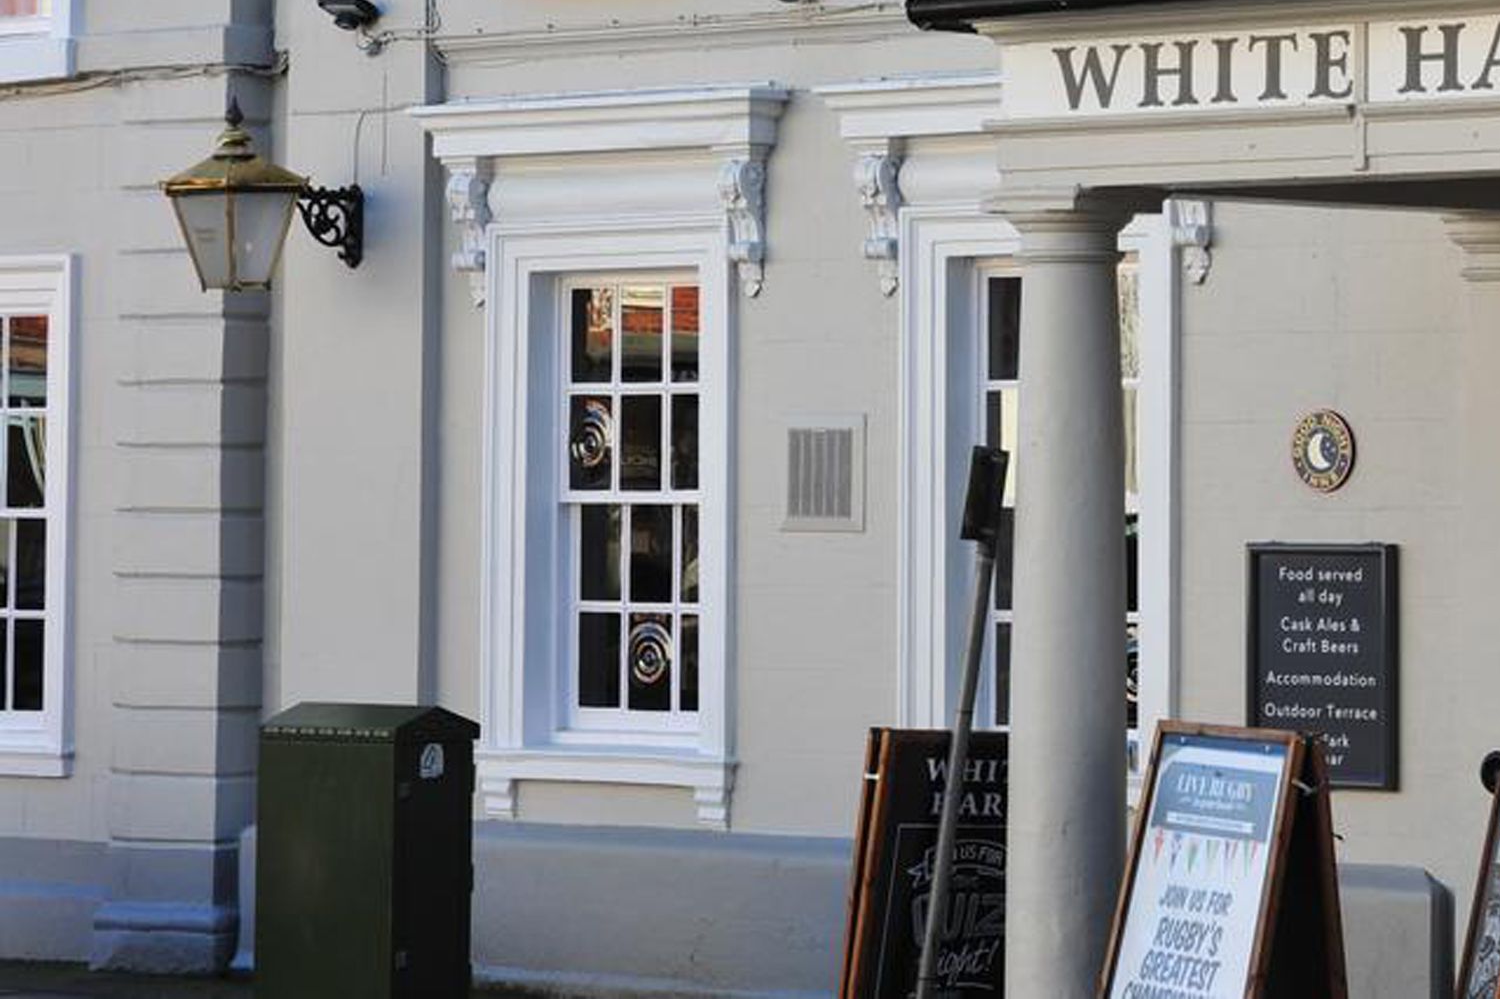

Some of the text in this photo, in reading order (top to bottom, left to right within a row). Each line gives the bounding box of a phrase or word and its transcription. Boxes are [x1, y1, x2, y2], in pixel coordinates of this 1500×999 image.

[1052, 30, 1355, 109] WHITE
[1278, 566, 1364, 582] Food served
[1298, 588, 1344, 607] all day
[1280, 616, 1361, 633] Cask Ales &
[1282, 638, 1359, 654] Craft Beers
[1265, 670, 1377, 688] Accommodation
[1264, 702, 1378, 721] Outdoor Terrace
[926, 758, 1007, 783] WHI
[1152, 916, 1224, 957] RUGBY'S
[1139, 948, 1221, 992] GREATEST
